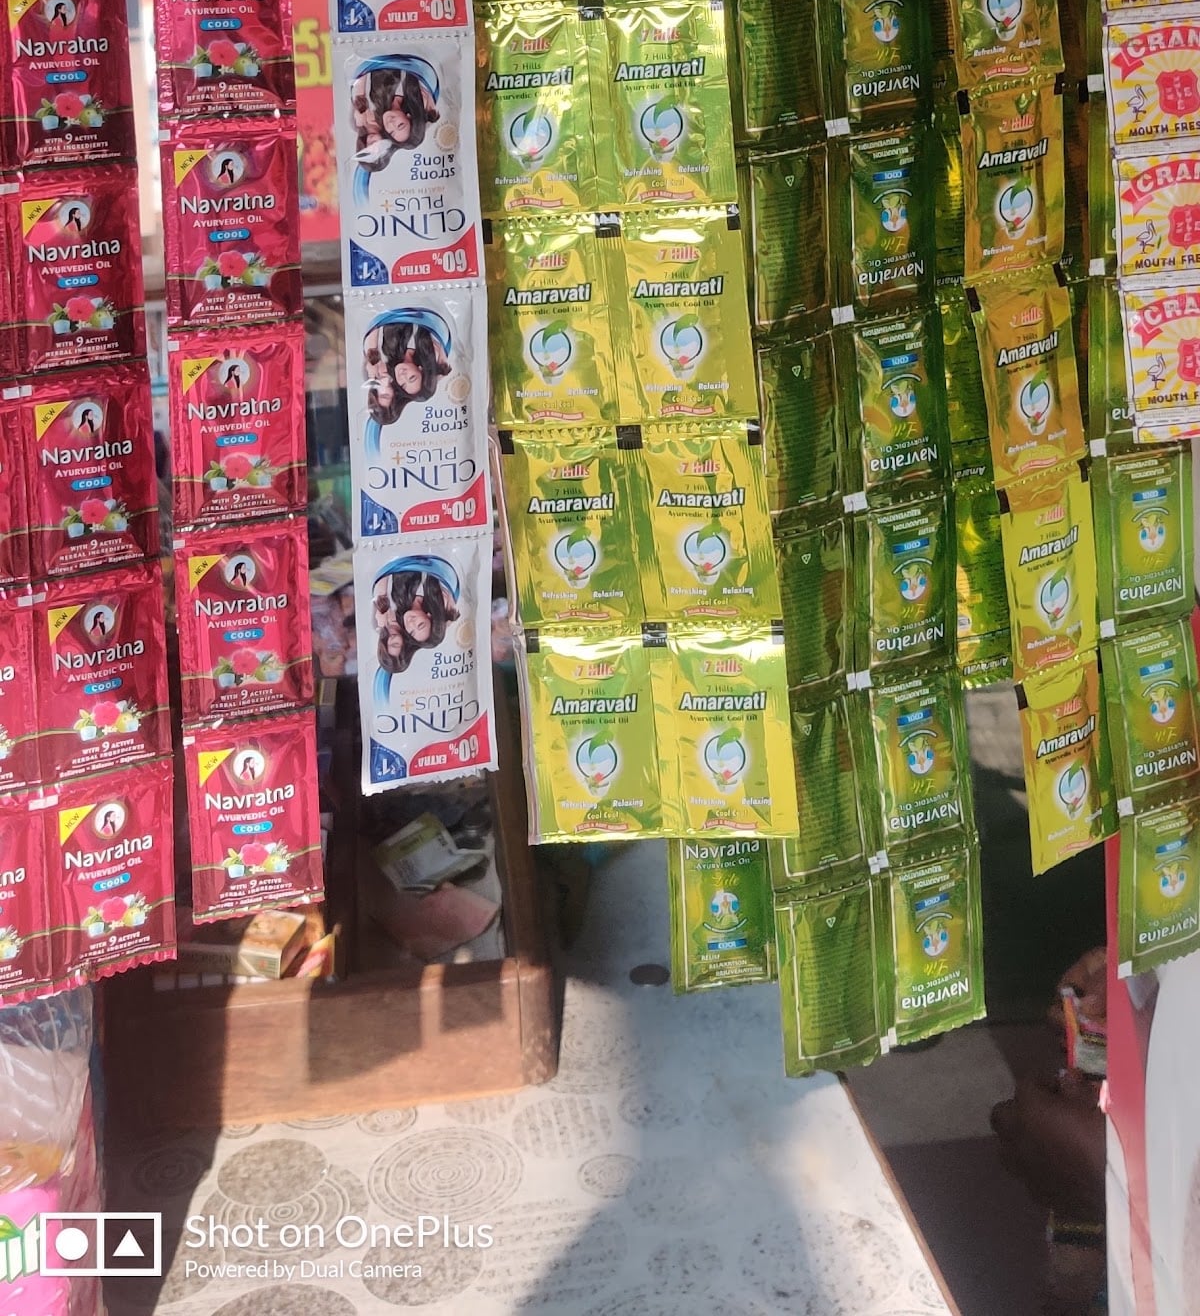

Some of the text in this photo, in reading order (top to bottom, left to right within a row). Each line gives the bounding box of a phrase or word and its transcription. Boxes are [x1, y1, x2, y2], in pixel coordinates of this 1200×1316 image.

[184, 5, 254, 15] AYURVEDIC OIL
[208, 20, 235, 28] COOL
[653, 28, 680, 41] Hills
[15, 36, 108, 56] Navratna
[487, 68, 573, 91] Amaravati
[615, 59, 704, 82] Amaravati
[852, 74, 920, 96] Navratna
[180, 154, 195, 170] NEW
[978, 140, 1047, 169] Amaravati
[624, 165, 709, 177] Refreshing Relaxing
[180, 194, 274, 214] Navratna
[357, 208, 465, 240] CLINIC
[28, 239, 120, 262] Navratna
[42, 260, 112, 274] AYURVEDIC OIL
[432, 250, 466, 273] 60%
[65, 277, 92, 286] COOL
[858, 261, 924, 285] Navratna
[506, 285, 591, 306] Amaravati
[635, 278, 723, 298] Amaravati
[998, 332, 1058, 366] Amaravati
[187, 362, 202, 378] NEW
[188, 397, 281, 421] Navratna
[200, 419, 270, 434] AYURVEDIC OIL
[224, 436, 250, 444] COOL
[42, 439, 132, 465] Navratna
[870, 444, 937, 472] Navratna
[79, 479, 106, 488] COOL
[368, 459, 475, 491] CLINIC
[528, 493, 614, 514] Amaravati
[658, 488, 744, 508] Amaravati
[1019, 526, 1079, 565] Amaravati
[671, 586, 753, 596] Refreshing Relaxing
[1120, 577, 1182, 601] Navratna
[195, 593, 287, 615] Navratna
[230, 631, 258, 640] COOL
[876, 625, 944, 651] Navratna
[54, 640, 144, 669] Navratna
[715, 660, 743, 673] Hills
[551, 694, 637, 716] Amaravati
[679, 691, 766, 711] Amaravati
[378, 699, 479, 734] CLINIC
[1135, 748, 1196, 778] Navratna
[204, 784, 294, 811] Navratna
[613, 799, 643, 808] Relaxing
[217, 806, 285, 822] AYURVEDIC OIL
[890, 800, 959, 830] Navratna
[240, 823, 266, 832] COOL
[65, 835, 153, 870] Navratna
[685, 839, 759, 860] Navratna
[100, 877, 125, 889] COOL
[901, 978, 969, 1009] Navratna
